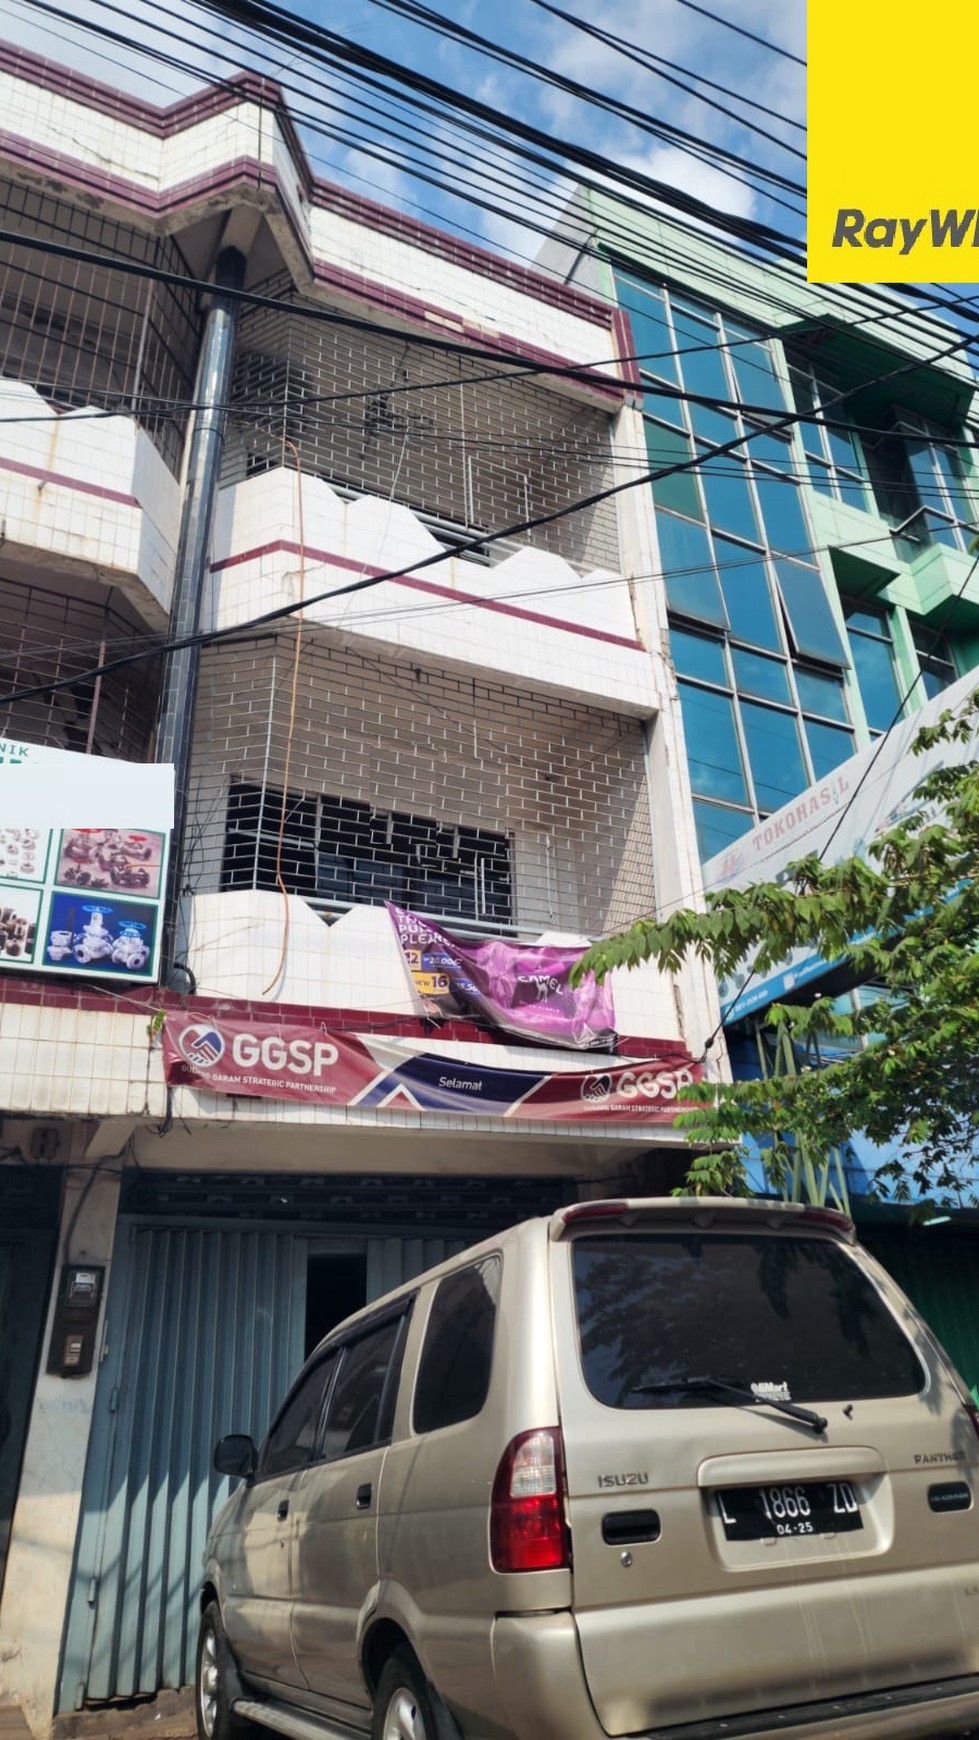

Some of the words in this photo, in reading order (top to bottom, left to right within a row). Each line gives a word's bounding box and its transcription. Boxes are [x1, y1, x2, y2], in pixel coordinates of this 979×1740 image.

[232, 1032, 339, 1077] GGSP
[242, 1074, 285, 1088] STRATEGIC
[285, 1081, 337, 1094] PARTNERSHIP
[438, 1076, 483, 1091] Selamat
[598, 1472, 649, 1488] ISUZU
[717, 1491, 737, 1524] L
[759, 1486, 811, 1519] 1866
